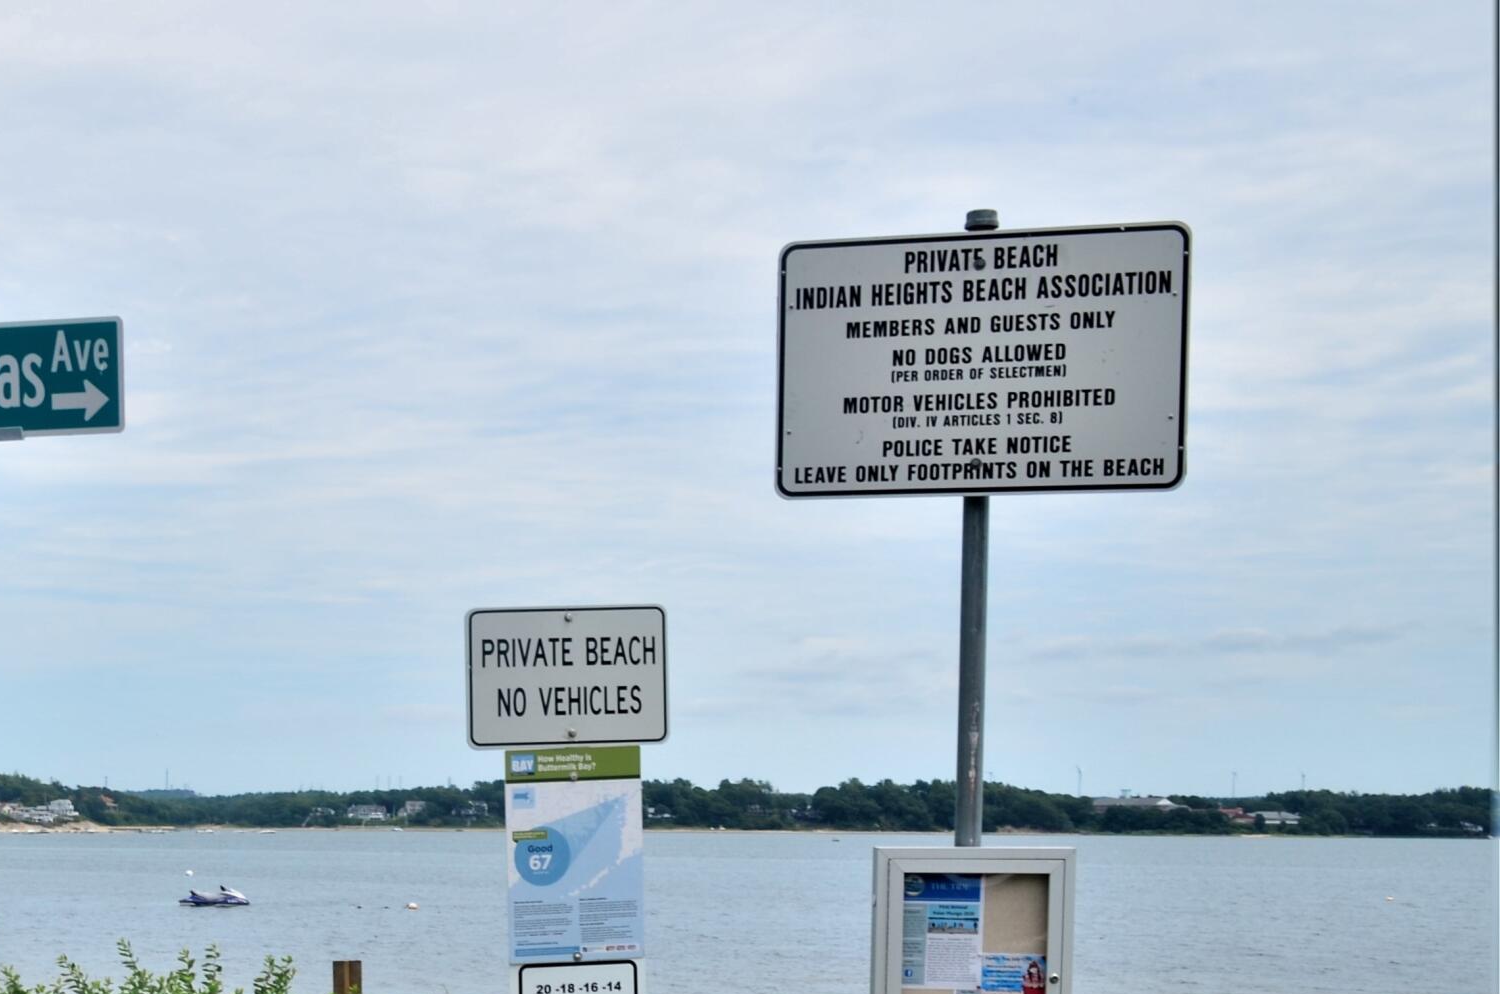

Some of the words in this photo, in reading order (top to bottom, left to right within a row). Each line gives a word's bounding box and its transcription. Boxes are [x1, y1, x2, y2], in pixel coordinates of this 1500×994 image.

[905, 248, 985, 273] PRIVATE
[994, 244, 1057, 269] BEACH
[795, 285, 861, 311] INDIAN
[872, 281, 952, 306] HEIGHTS
[963, 278, 1026, 302] BEACH
[1037, 271, 1172, 299] ASSOCIATION
[847, 319, 934, 338] MEMBERS
[945, 317, 980, 334] AND
[991, 313, 1060, 332] GUESTS
[1071, 311, 1115, 329] ONLY
[51, 330, 108, 372] Ave
[893, 349, 915, 366] NO
[926, 347, 972, 365] DOGS
[982, 344, 1066, 363] ALLOWED
[925, 369, 963, 381] ORDER
[970, 368, 983, 379] OF
[844, 396, 903, 414] MOTOR
[914, 392, 997, 411] VEHICLES
[1008, 389, 1115, 408] PROHIBITED
[927, 416, 937, 427] IV
[944, 414, 1000, 426] ARTICLES
[1017, 413, 1043, 424] SEC.
[883, 440, 942, 457] POLICE
[952, 438, 996, 455] TAKE
[1007, 436, 1071, 454] NOTICE
[795, 466, 846, 483] LEAVE
[856, 465, 898, 482] ONLY
[908, 461, 1016, 481] FOOTPRINTS
[1027, 461, 1050, 478] ON
[1060, 460, 1093, 477] THE
[1104, 458, 1164, 476] BEACH
[482, 638, 573, 667] PRIVATE
[586, 636, 655, 665] BEACH
[498, 688, 526, 716] NO
[539, 685, 641, 715] VEHICLES
[512, 760, 533, 772] BAY
[528, 844, 553, 852] Good
[530, 855, 552, 870] 67
[537, 985, 551, 994] 20
